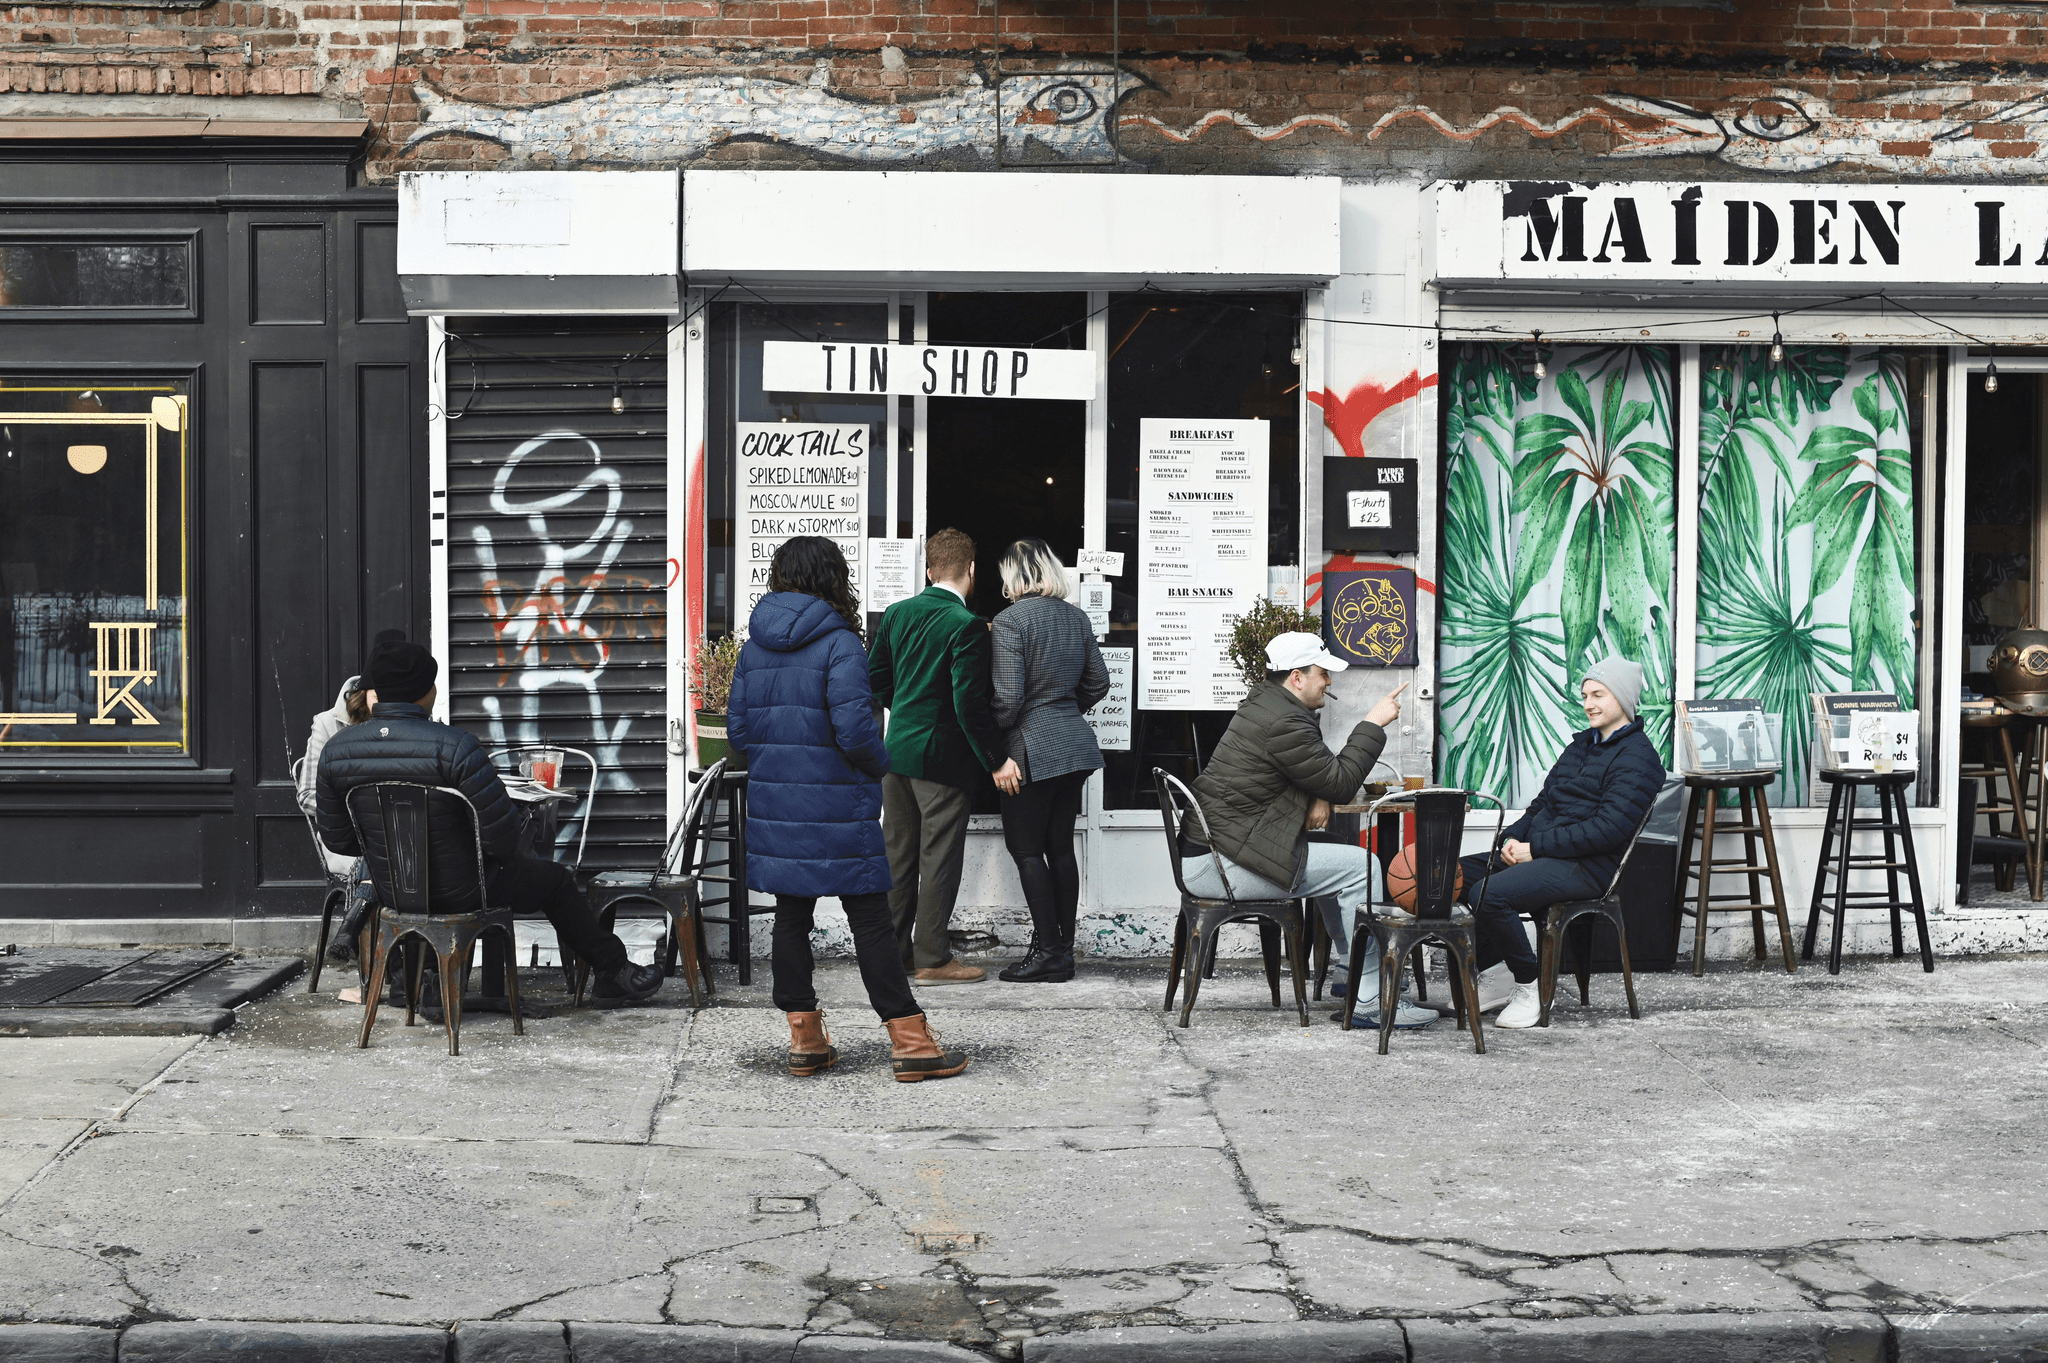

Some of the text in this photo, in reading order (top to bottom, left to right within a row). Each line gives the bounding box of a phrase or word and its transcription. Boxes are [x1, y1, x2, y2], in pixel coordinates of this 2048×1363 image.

[1520, 196, 2048, 265] MAIDEN L
[822, 345, 1029, 397] TIN SHOP
[1169, 430, 1235, 439] BREAKFAST
[741, 428, 864, 458] COCKTAILS
[749, 467, 858, 484] SPIKED LEMONADE $10
[1377, 467, 1404, 475] MAIDEN
[1377, 473, 1404, 484] LANE
[1168, 492, 1233, 500] SANDWICHES
[750, 494, 855, 510] MOSCOW MULE $10
[1351, 497, 1385, 508] T-shirts
[1360, 512, 1380, 523] $25
[751, 518, 859, 534] DARK N STORMY $10
[1168, 588, 1233, 596] BAR SNACKS
[1896, 733, 1908, 745] $4
